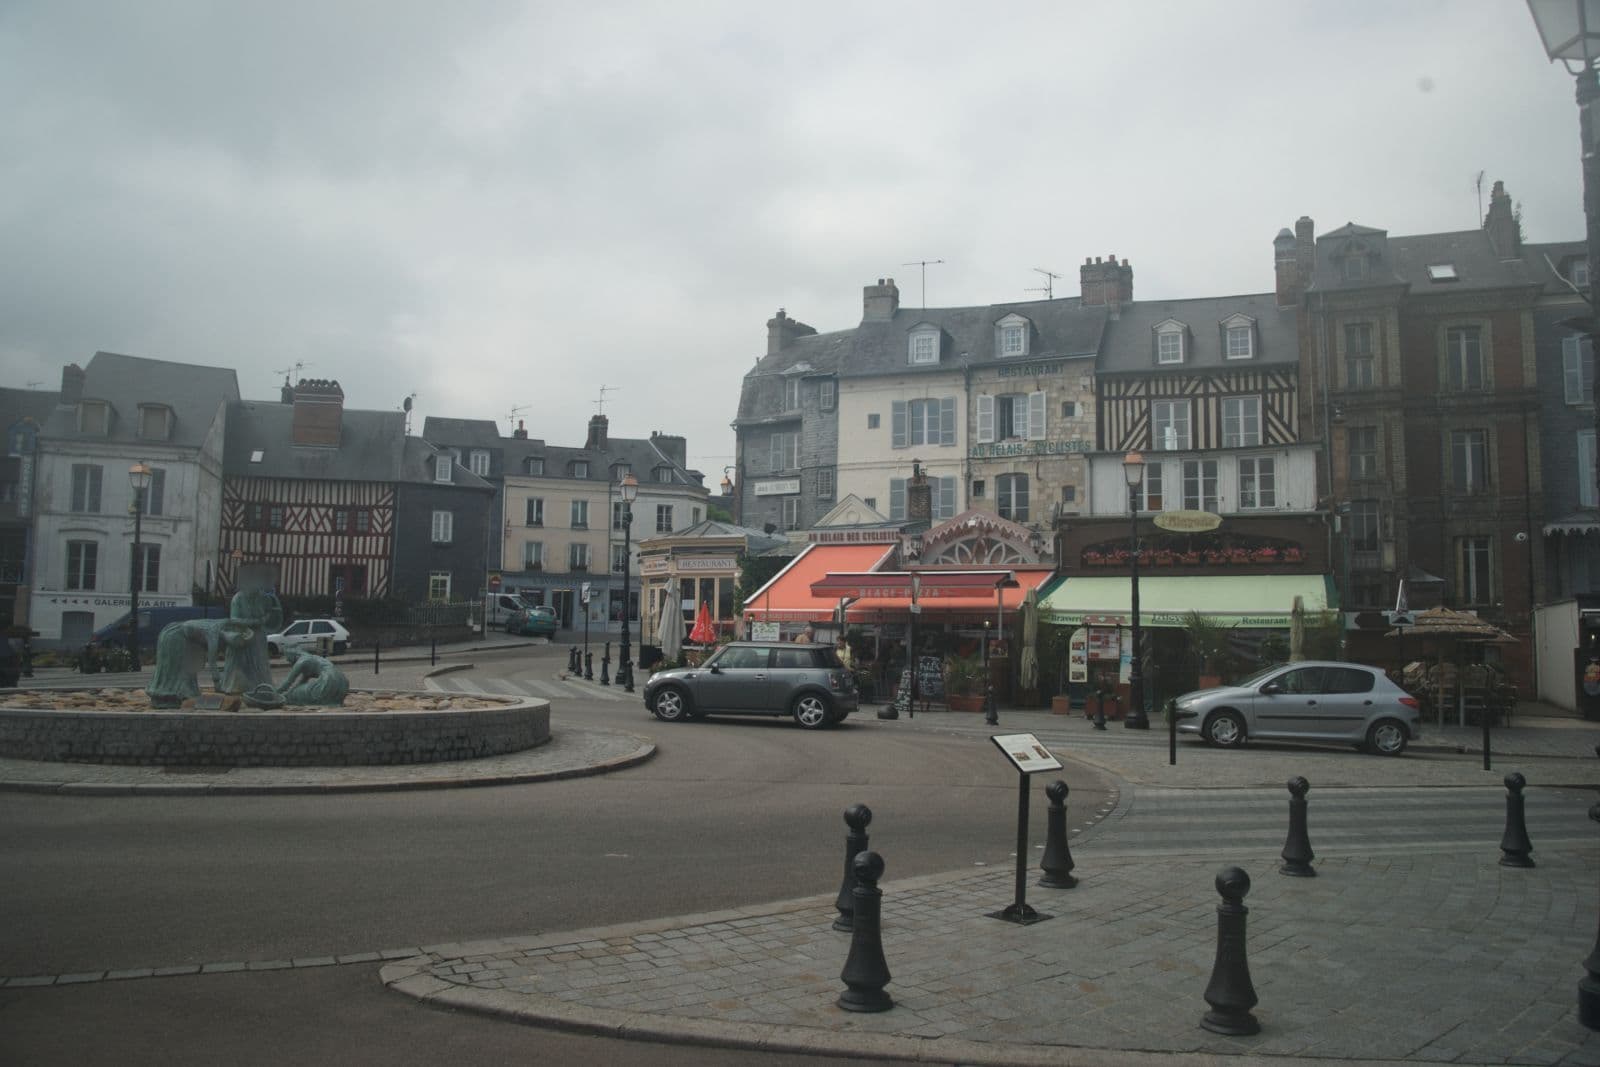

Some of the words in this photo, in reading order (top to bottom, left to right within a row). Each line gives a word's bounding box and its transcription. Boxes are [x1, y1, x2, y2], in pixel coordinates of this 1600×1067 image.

[998, 364, 1063, 377] RESTAURANT
[682, 560, 731, 568] RESTAURANT
[1242, 616, 1287, 625] Restaurant
